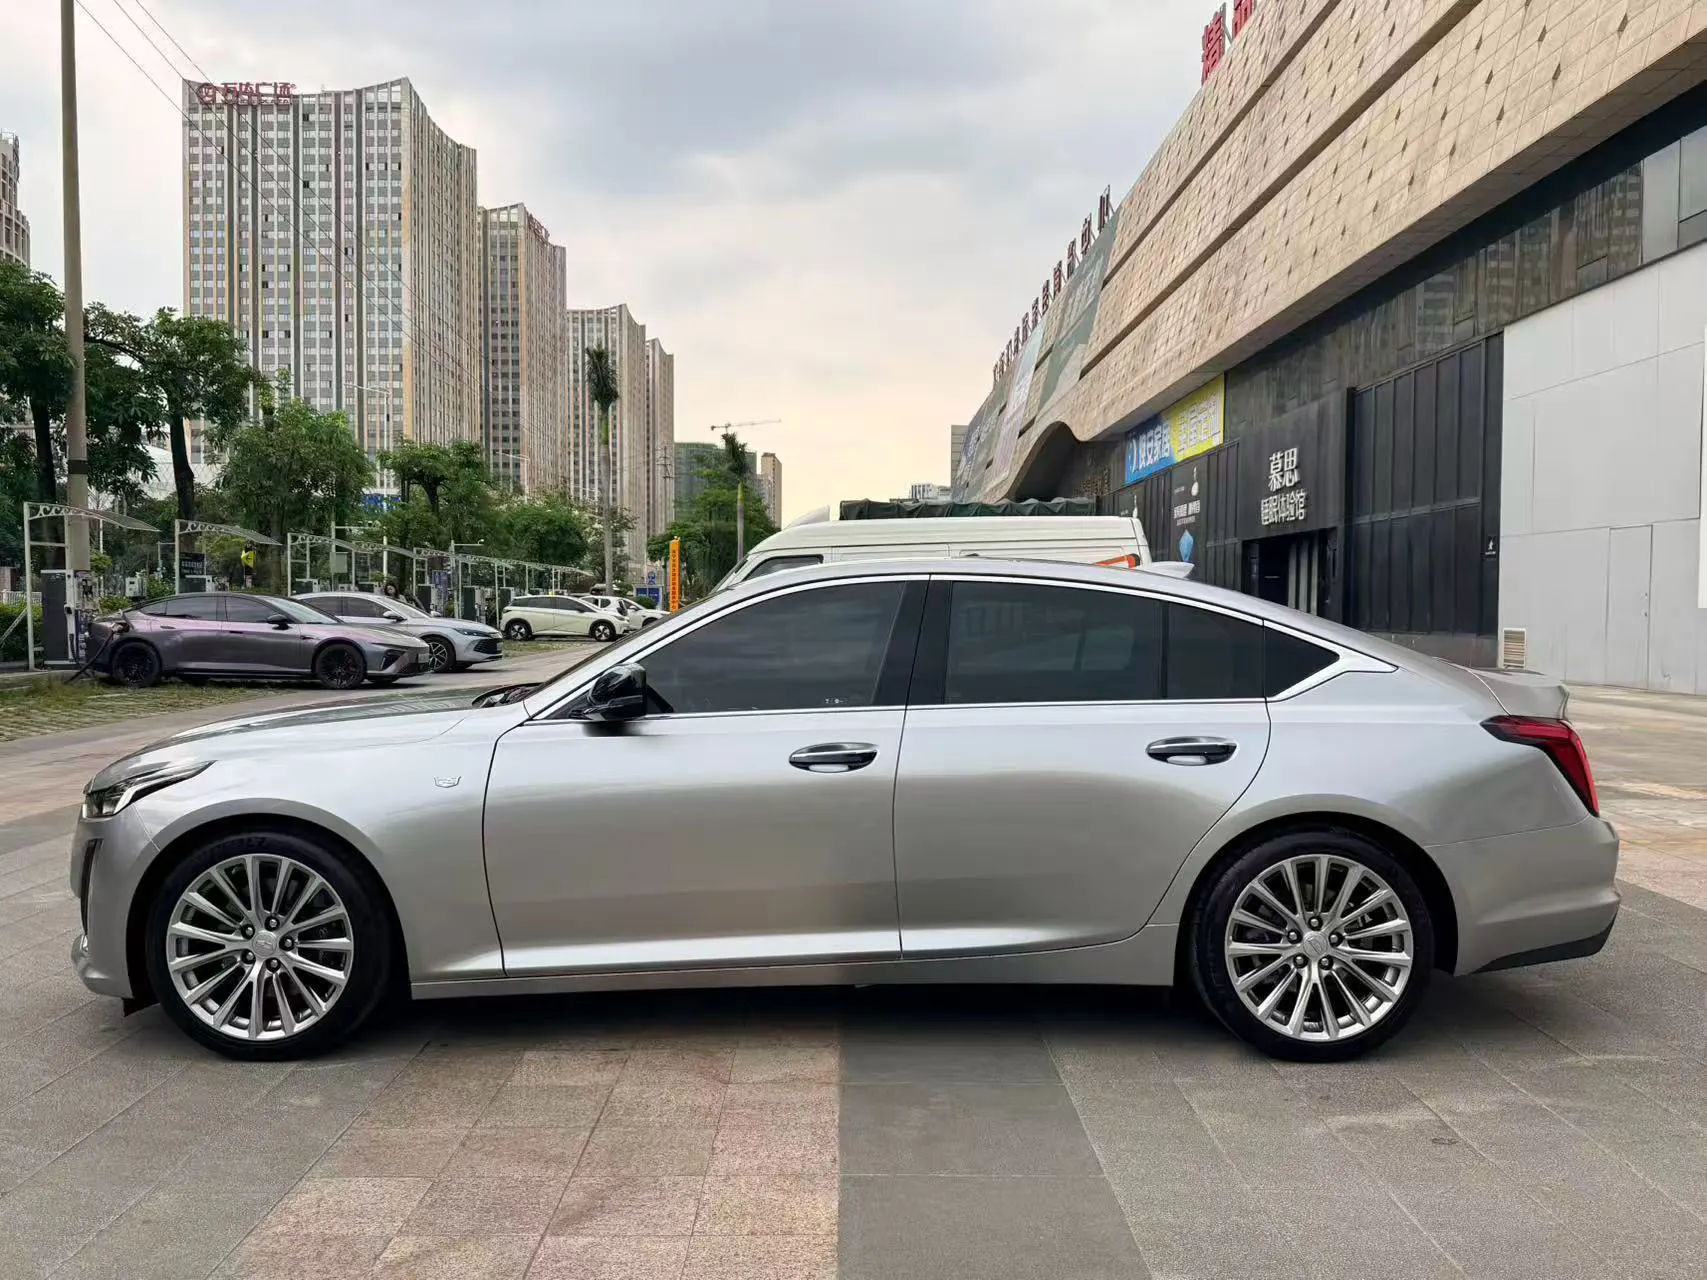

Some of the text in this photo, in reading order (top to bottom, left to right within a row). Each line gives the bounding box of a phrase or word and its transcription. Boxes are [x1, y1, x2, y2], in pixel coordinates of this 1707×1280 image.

[1268, 447, 1300, 491] 慕思
[1261, 488, 1307, 525] 睡眠体验馆
